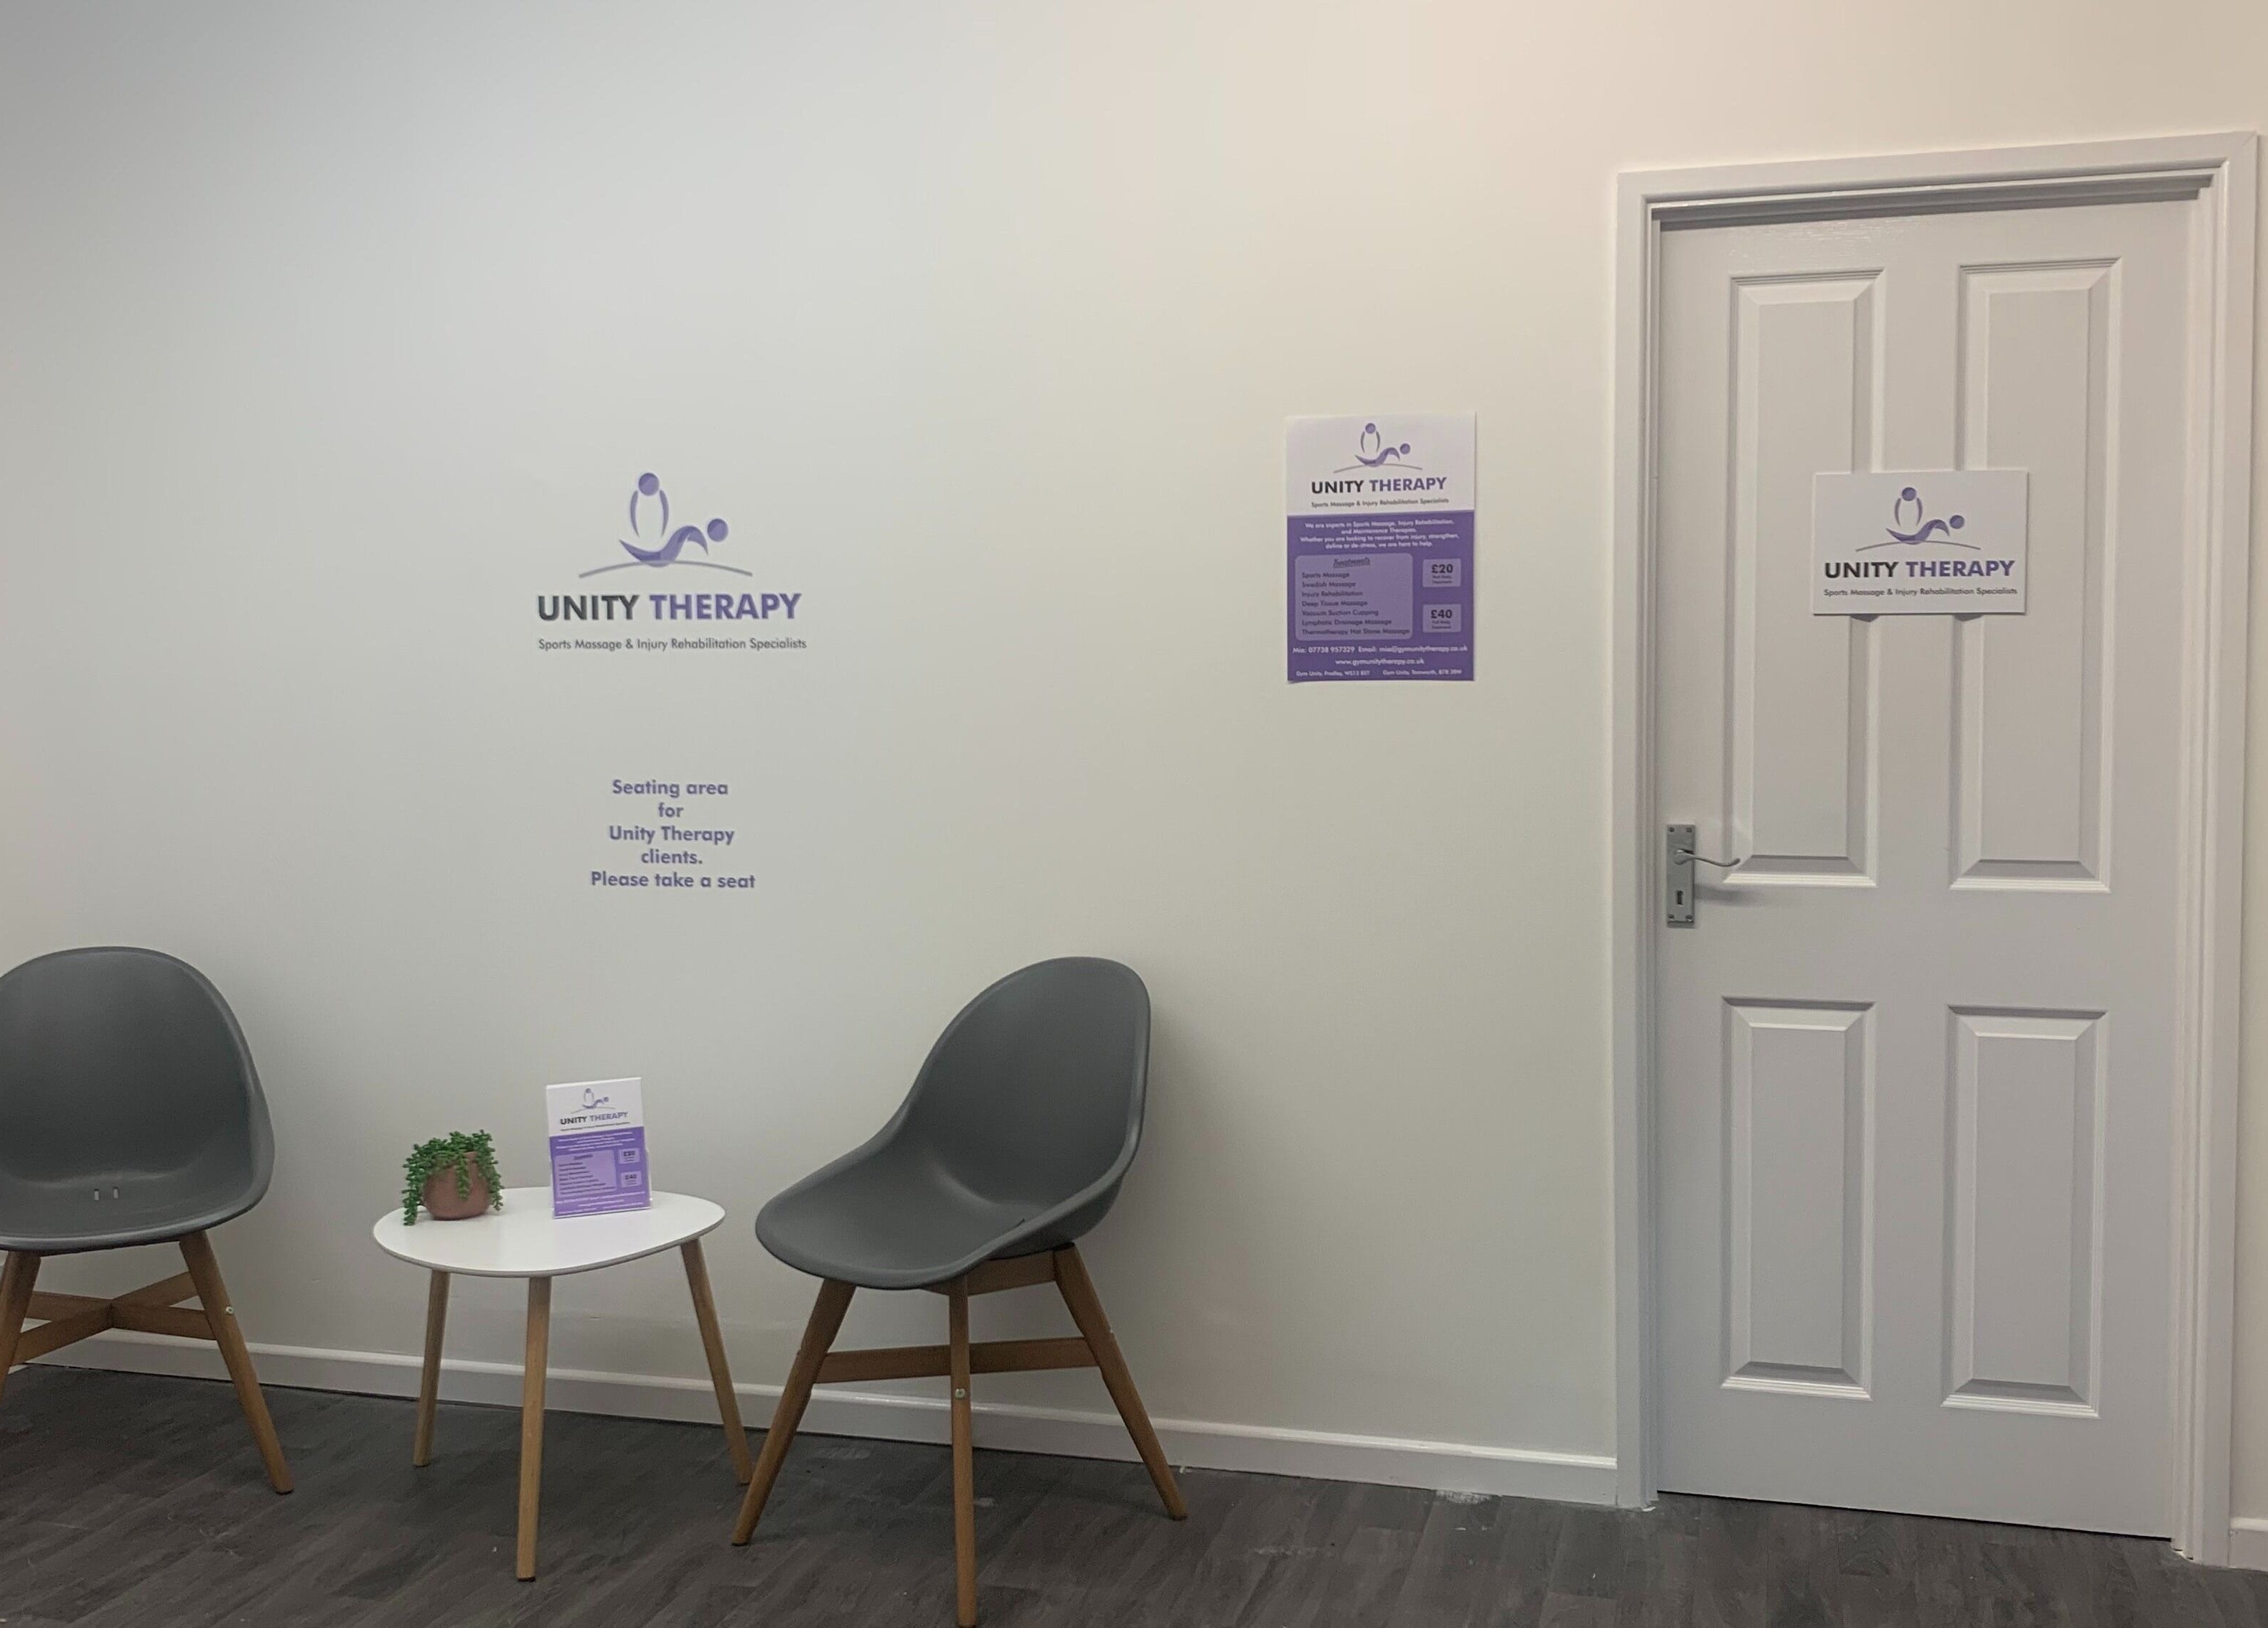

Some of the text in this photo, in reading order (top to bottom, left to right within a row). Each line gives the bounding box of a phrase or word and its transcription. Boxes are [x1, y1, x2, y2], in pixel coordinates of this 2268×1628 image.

[1311, 477, 1447, 494] UNITY THERAPY
[1431, 563, 1453, 574] £20
[1824, 560, 2015, 579] UNITY THERAPY
[1824, 589, 1847, 597] Sports
[1850, 589, 1885, 597] Massage
[1896, 587, 1918, 597] Injury
[1920, 586, 1974, 595] Rehabilitation
[1977, 586, 2018, 596] Specialists
[538, 593, 802, 621] UNITY THERAPY
[1430, 609, 1453, 618] £40
[538, 637, 807, 652] Sports Massage & Injury Rehabilitation Specialists
[612, 780, 728, 797] Seating area
[658, 803, 684, 818] for
[609, 825, 735, 846] Unity Therapy
[641, 849, 703, 864] clients.
[591, 871, 755, 889] Please take a seat
[560, 1111, 628, 1125] UNITY THERAPY
